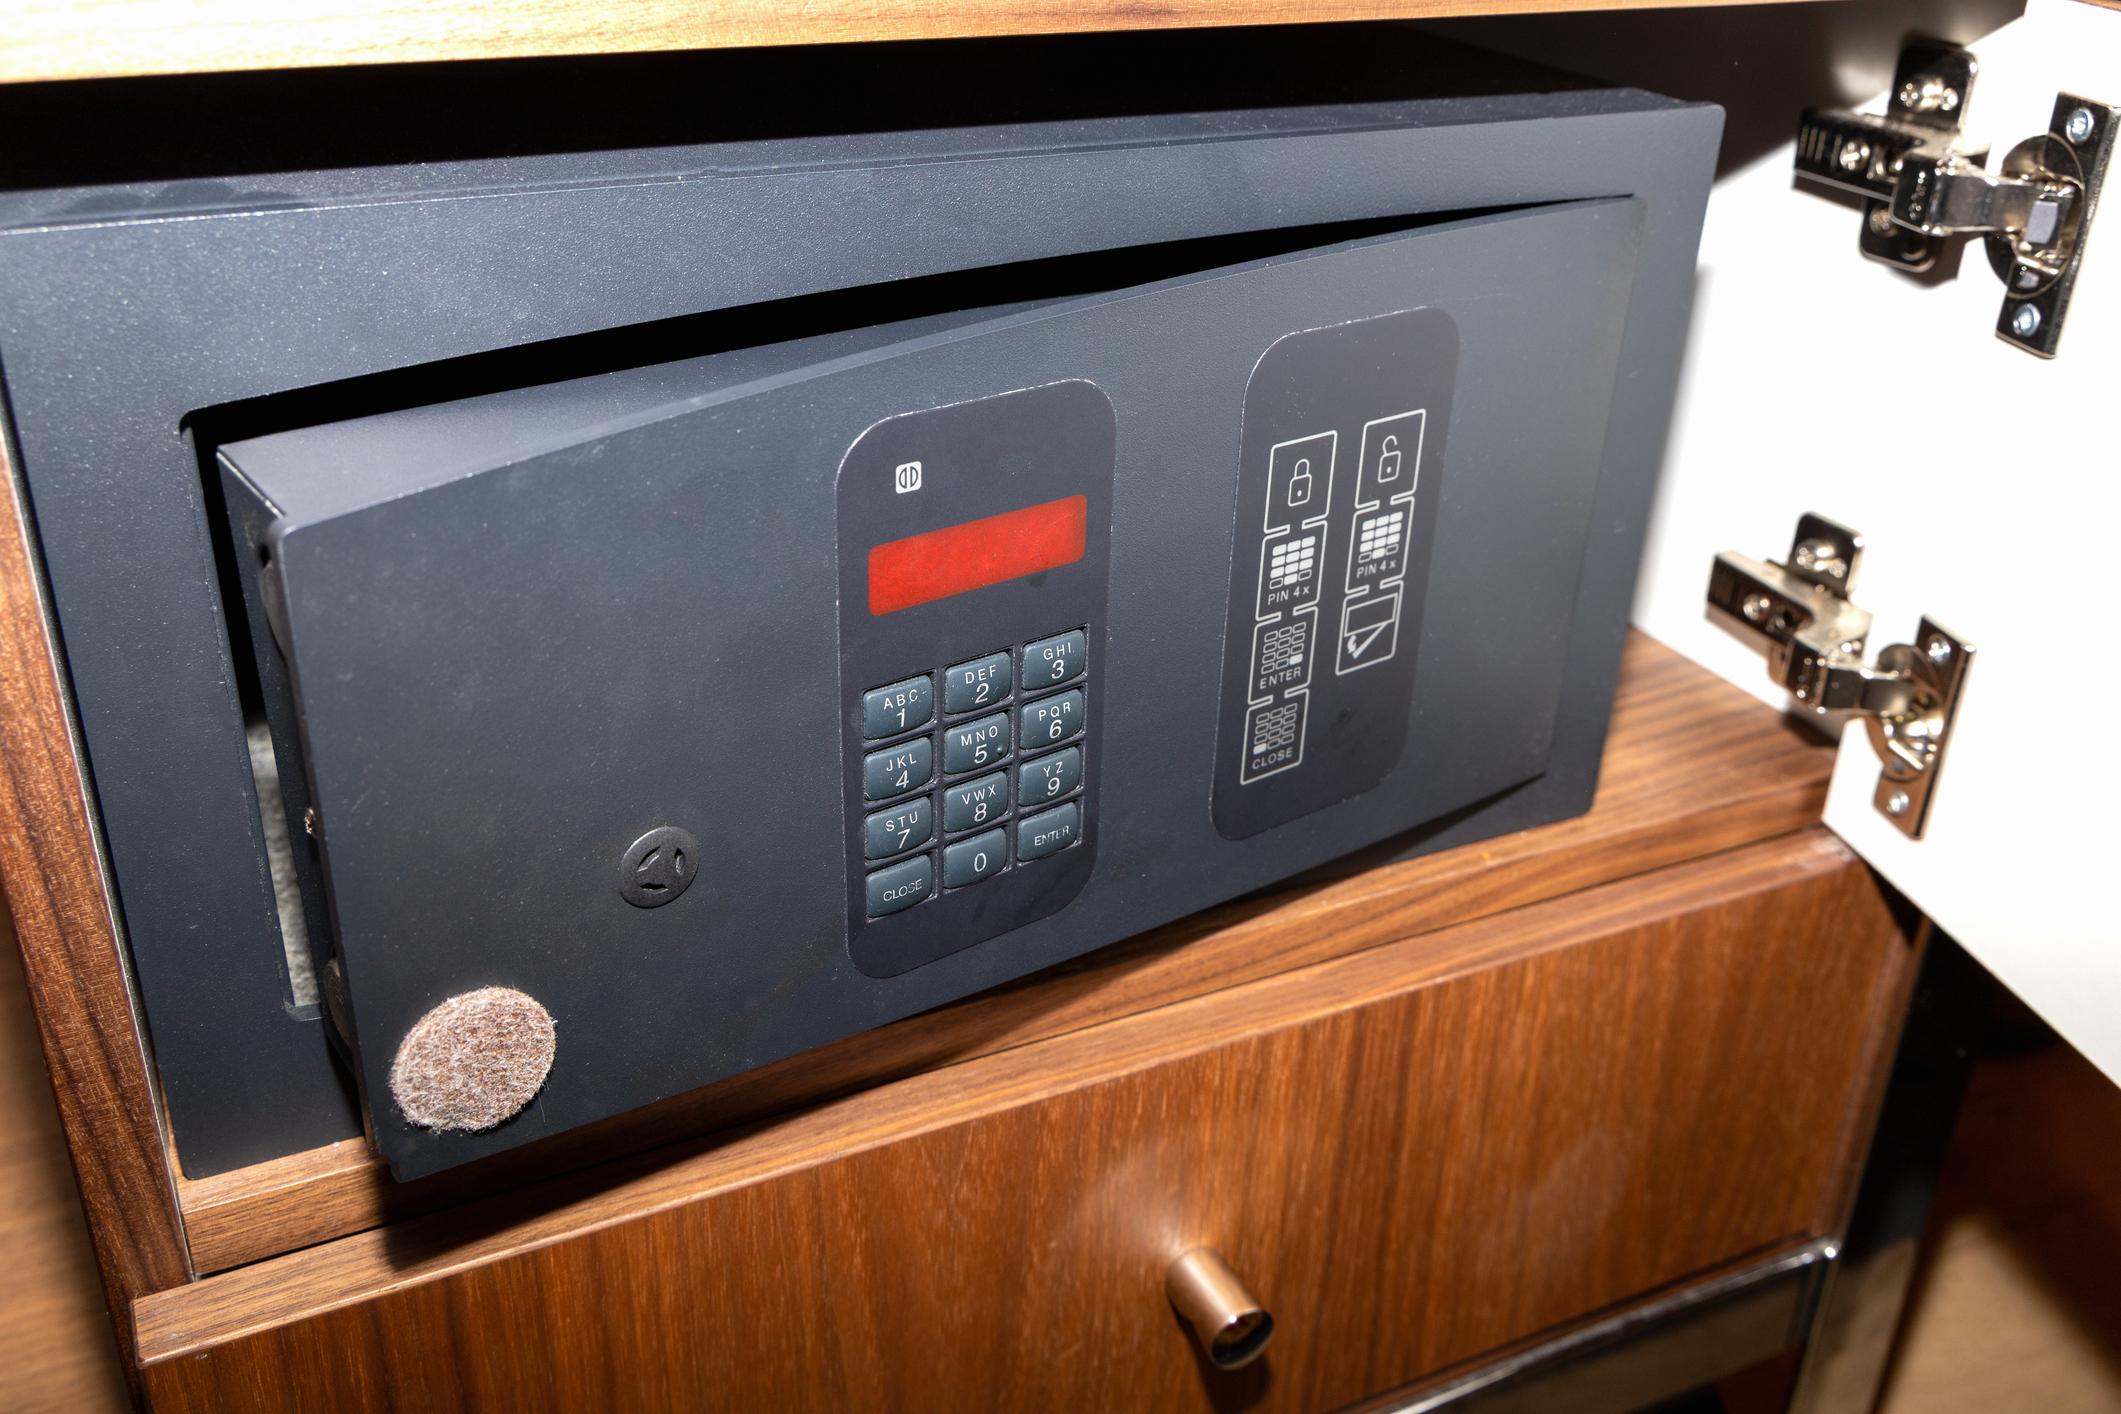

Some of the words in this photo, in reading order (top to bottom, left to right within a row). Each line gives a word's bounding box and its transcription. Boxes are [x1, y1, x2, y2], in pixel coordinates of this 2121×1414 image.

[1356, 563, 1377, 579] PIN
[1267, 588, 1289, 606] PIN
[1043, 642, 1072, 661] GHI
[965, 664, 998, 684] DEF
[1051, 659, 1065, 680] 3
[1260, 667, 1302, 690] ENTER
[883, 689, 919, 711] ABC
[974, 682, 990, 704] 2
[896, 709, 906, 728] 1
[1038, 702, 1071, 721] PQR
[960, 725, 998, 747] MNO
[1049, 719, 1063, 740] 6
[886, 752, 917, 772] JKL
[973, 743, 988, 764] 5
[1252, 748, 1294, 771] CLOSE
[1043, 761, 1064, 776] YZ
[895, 772, 909, 789] 4
[1047, 777, 1061, 797] 9
[961, 783, 996, 806] VWX
[885, 811, 919, 832] STU
[974, 802, 987, 822] 8
[896, 828, 911, 849] 7
[1034, 825, 1070, 846] ENTER
[973, 853, 987, 872] 0
[883, 879, 923, 902] CLOSE
